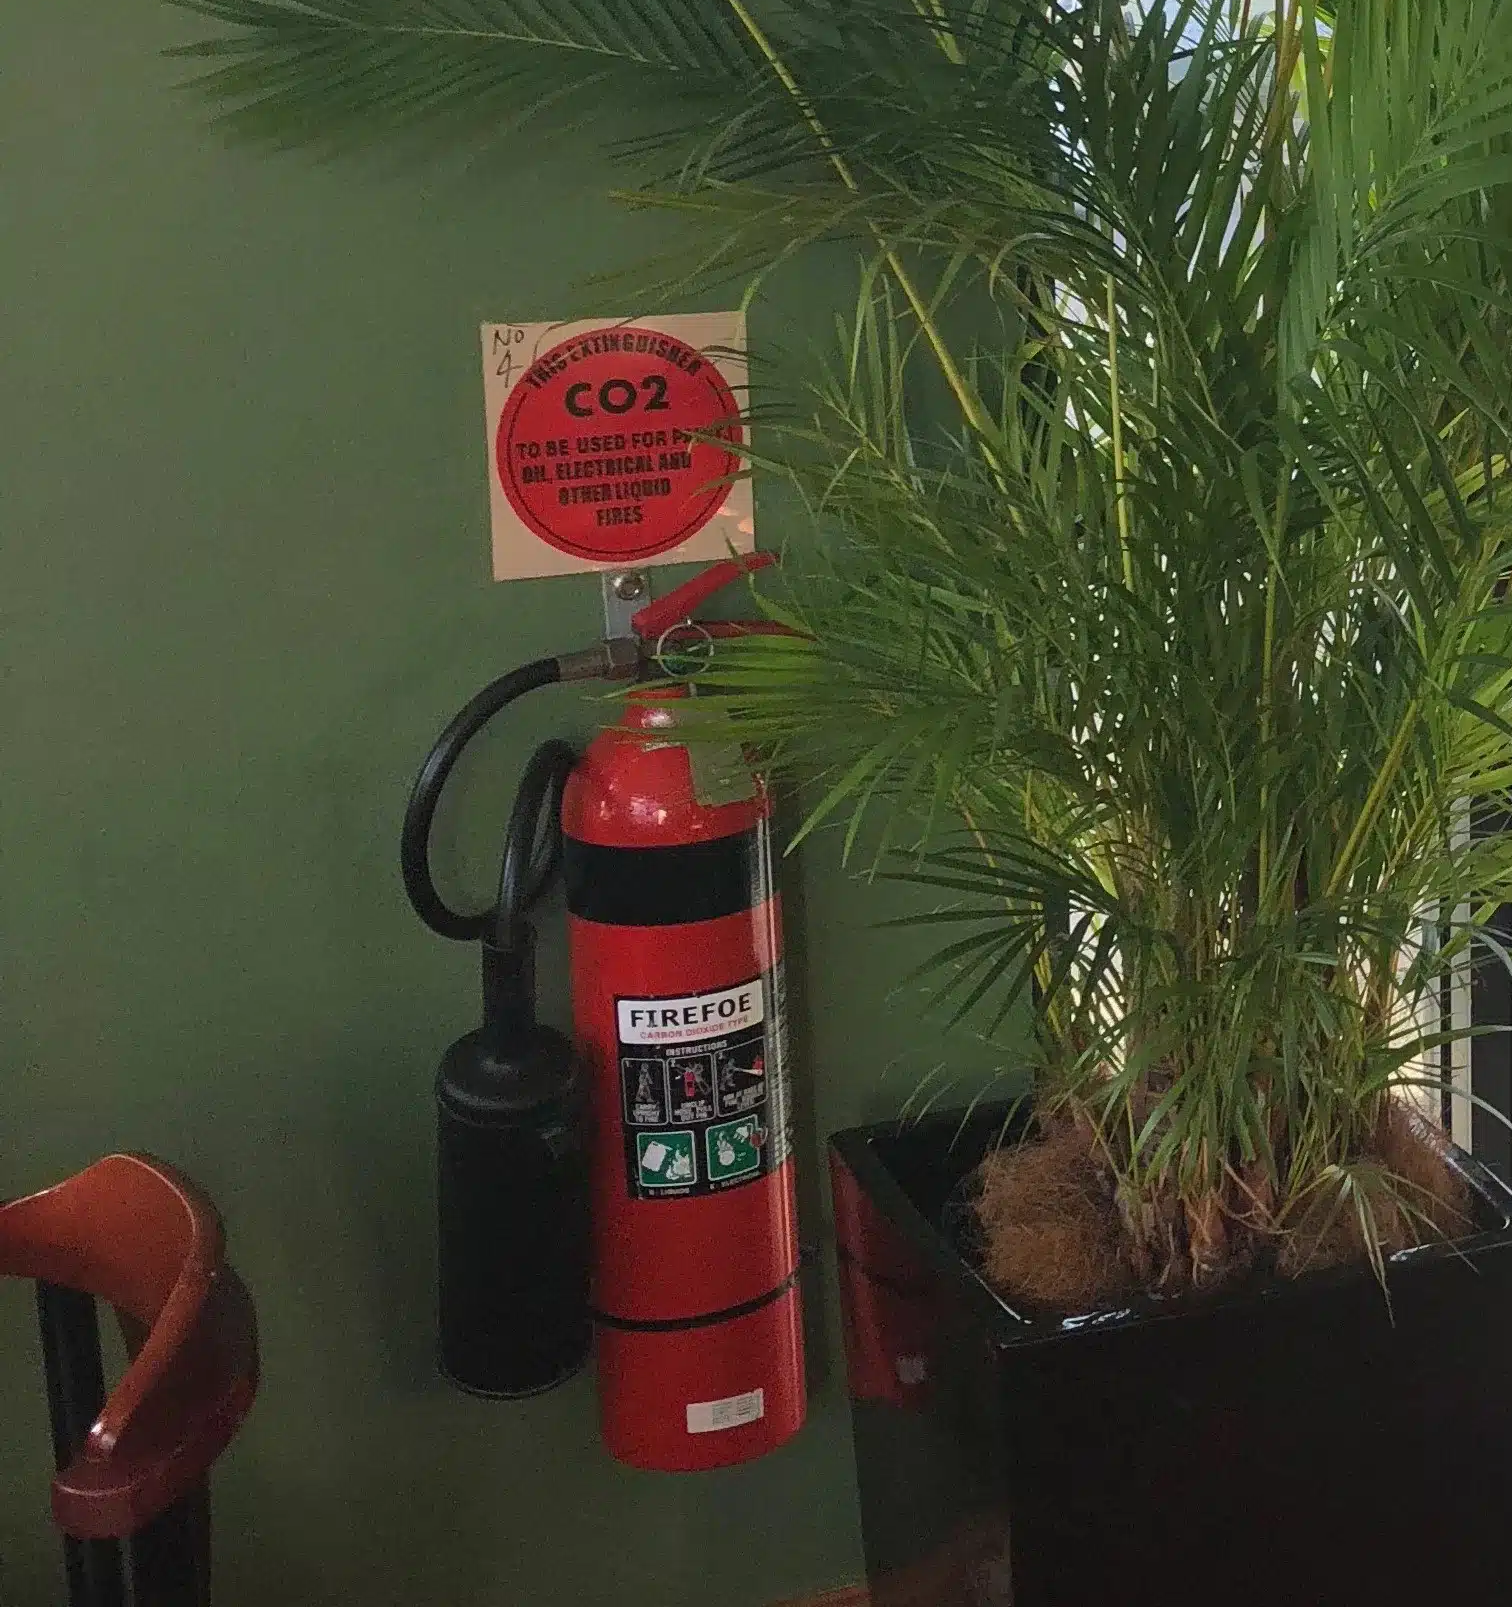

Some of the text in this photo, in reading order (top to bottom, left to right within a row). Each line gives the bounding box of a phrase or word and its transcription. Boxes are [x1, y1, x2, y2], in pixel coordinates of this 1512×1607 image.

[495, 349, 524, 388] 4
[563, 375, 672, 418] CO2
[516, 443, 542, 459] TO
[545, 439, 569, 456] BE
[576, 433, 625, 454] USED
[631, 430, 667, 449] FOR
[555, 454, 654, 481] ELECTRICAL
[659, 451, 691, 471] AND
[558, 477, 672, 506] OTHER LIQUID
[596, 505, 644, 527] FIRES
[630, 992, 751, 1028] FIREFOE
[640, 1014, 749, 1040] CARBON DIOXIDE TYPE
